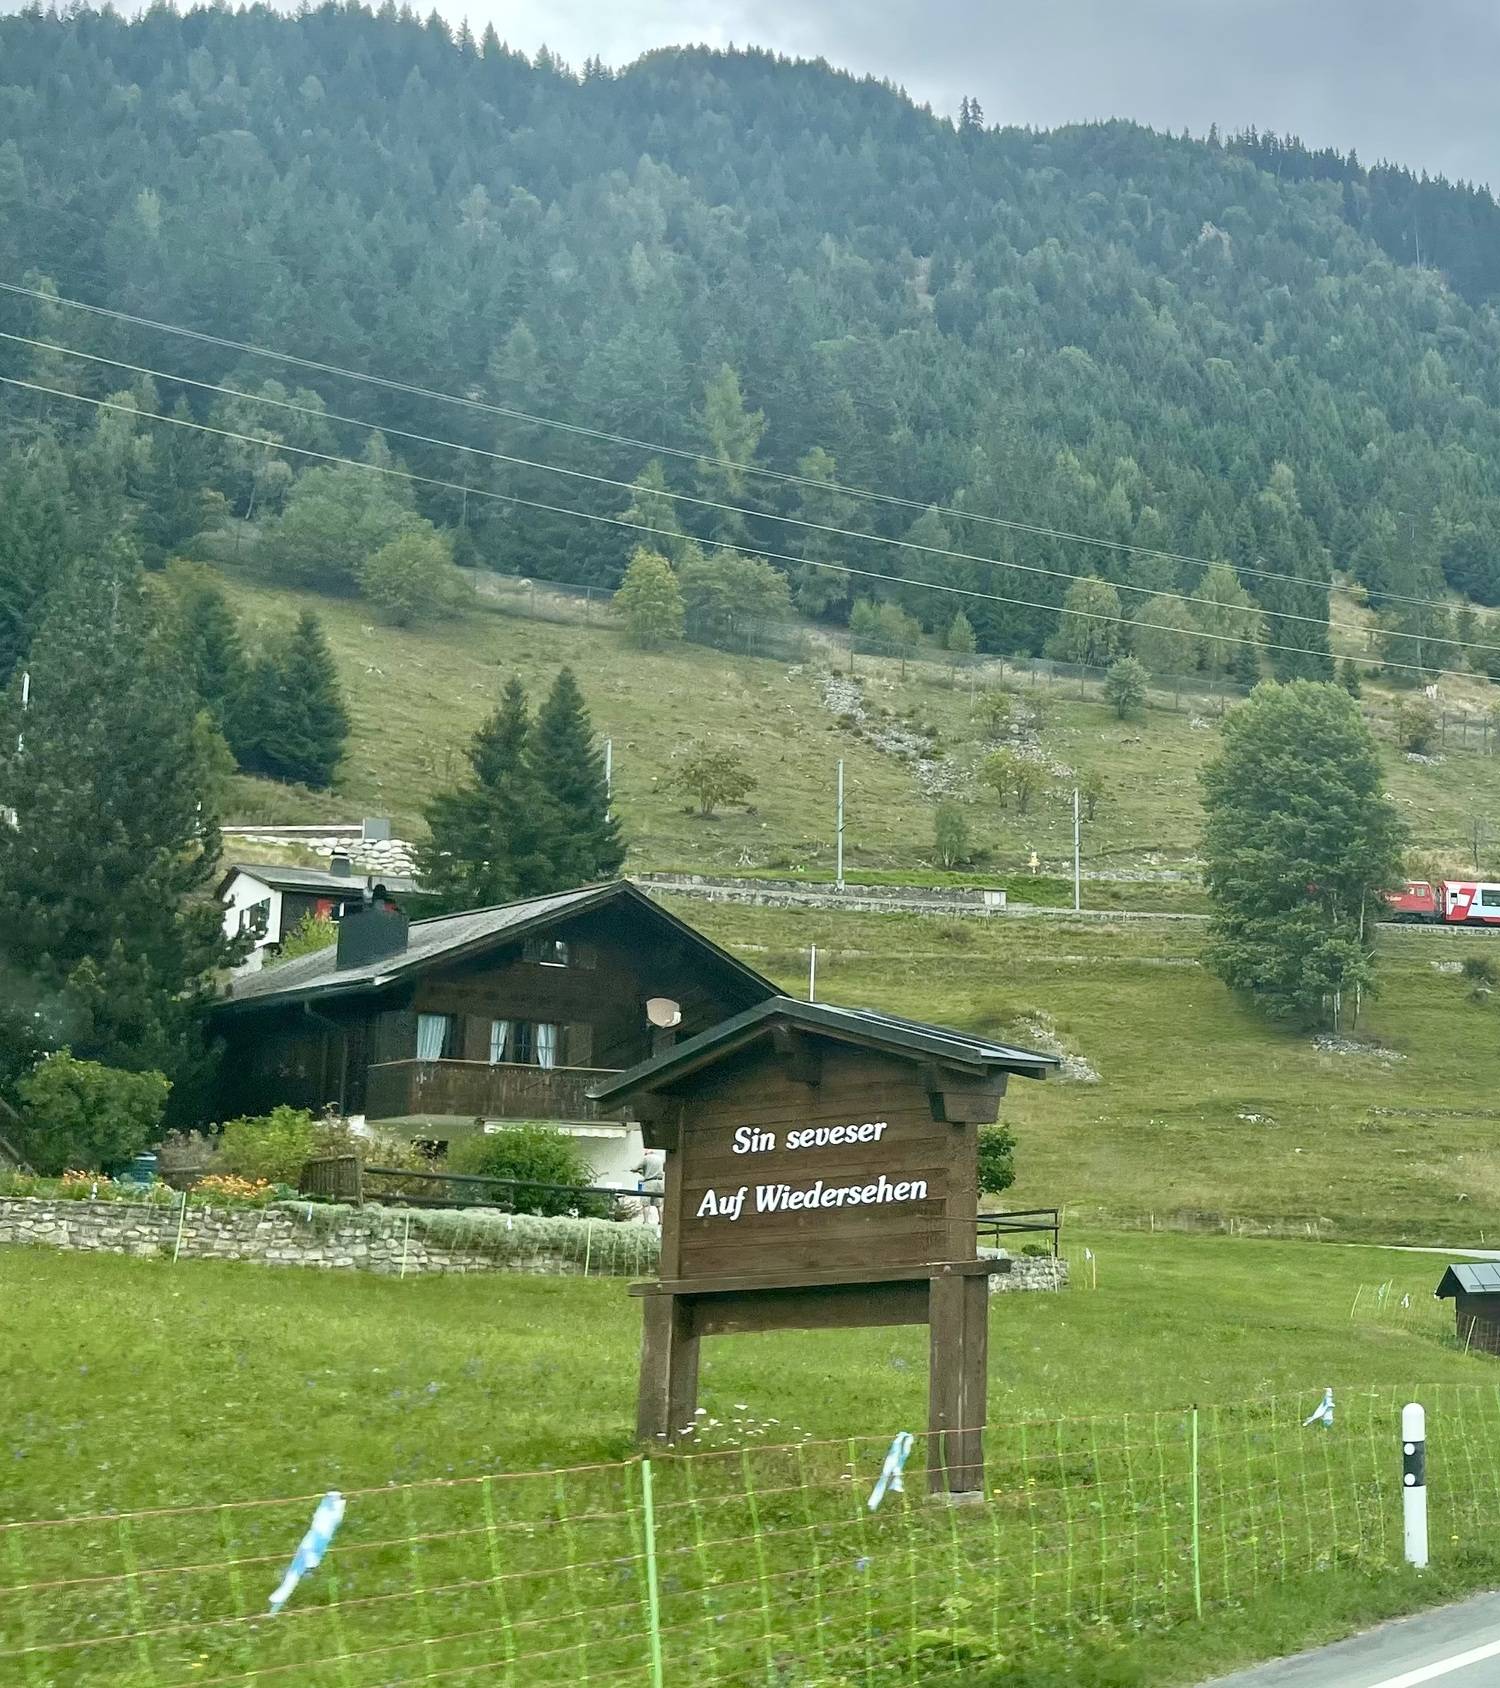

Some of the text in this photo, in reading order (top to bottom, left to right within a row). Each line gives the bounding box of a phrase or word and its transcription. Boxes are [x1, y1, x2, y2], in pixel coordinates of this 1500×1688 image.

[732, 1121, 887, 1154] Sin seveser
[696, 1175, 928, 1221] Auf Wiedersehen
